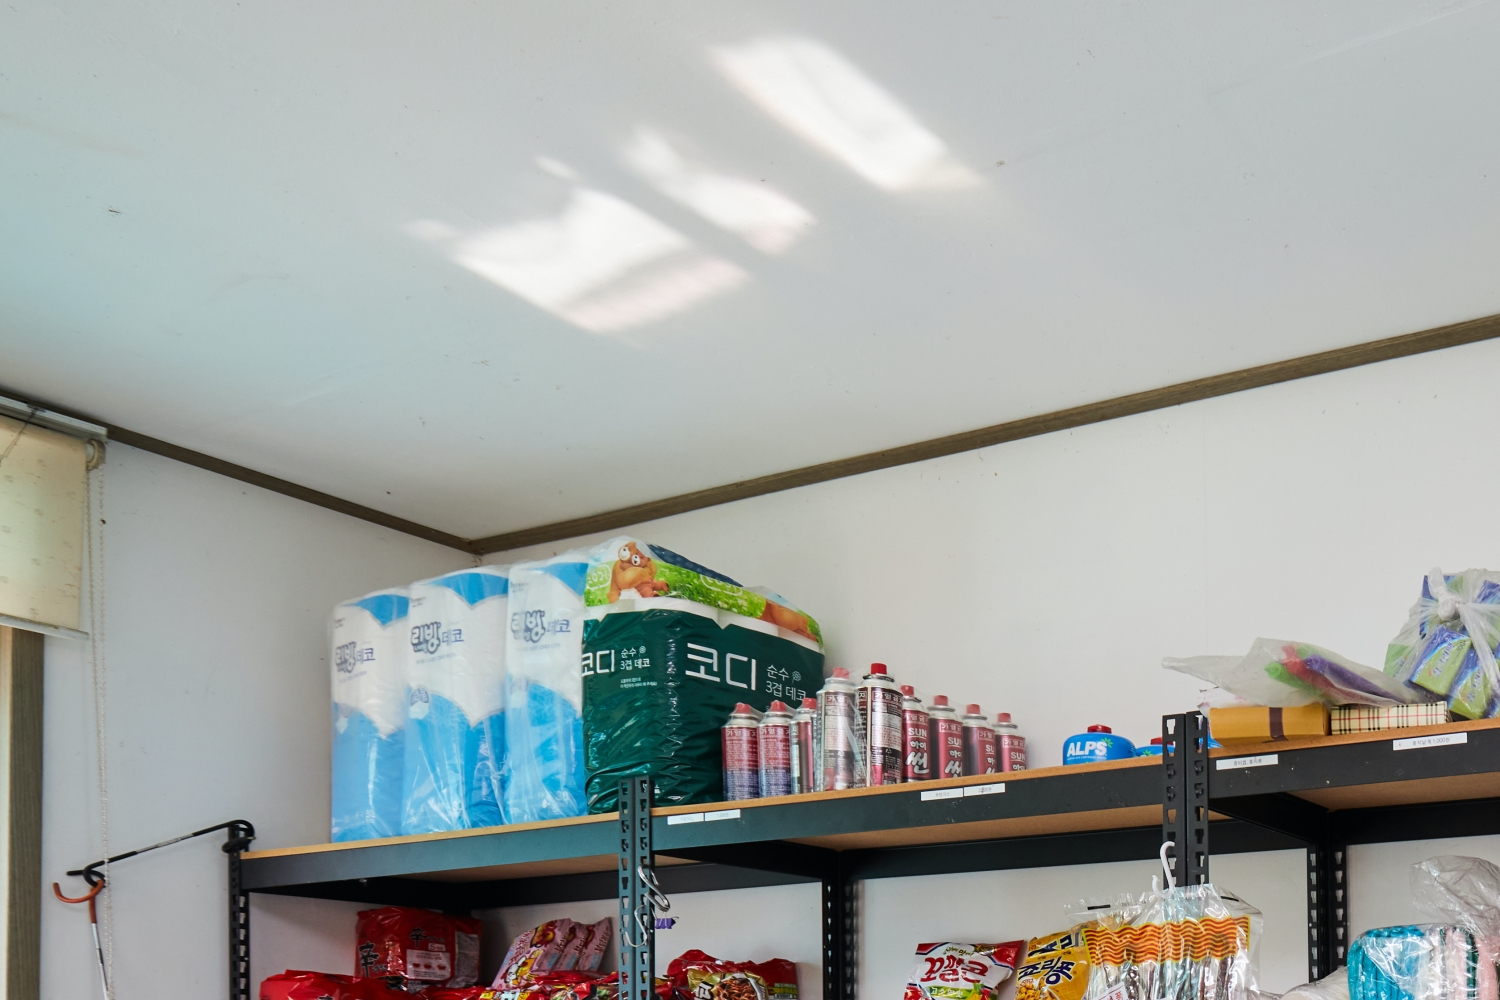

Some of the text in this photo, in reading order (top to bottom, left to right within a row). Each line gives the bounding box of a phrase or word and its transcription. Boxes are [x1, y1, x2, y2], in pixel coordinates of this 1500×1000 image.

[442, 628, 464, 643] 데코
[356, 648, 376, 662] 데코
[621, 648, 637, 659] 순수
[581, 649, 615, 677] 코디
[620, 658, 651, 670] 3겹 데코
[685, 642, 757, 691] 코디
[765, 664, 790, 681] 순수
[765, 680, 807, 702] 3겹 데코
[908, 727, 928, 738] SUN
[1067, 742, 1108, 758] ALPS
[920, 954, 989, 983] 꼬깔콘
[1018, 956, 1075, 986] 죠리퐁
